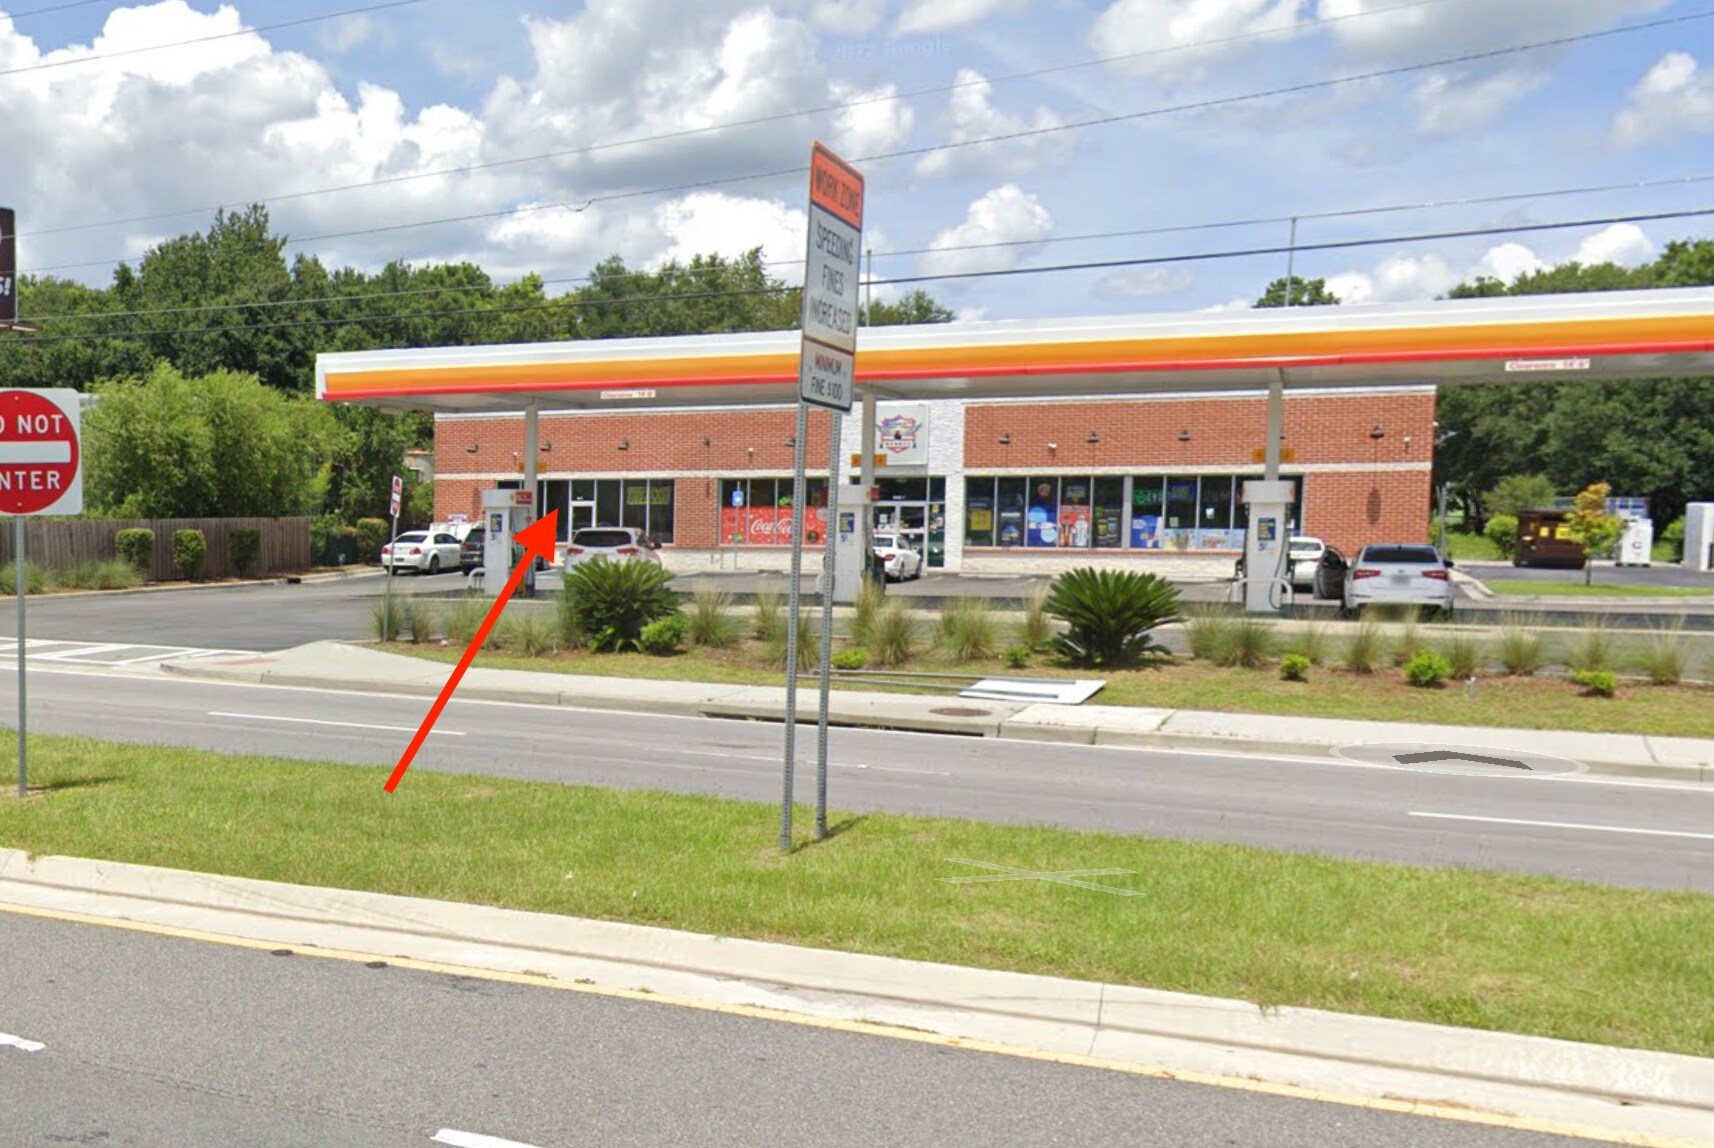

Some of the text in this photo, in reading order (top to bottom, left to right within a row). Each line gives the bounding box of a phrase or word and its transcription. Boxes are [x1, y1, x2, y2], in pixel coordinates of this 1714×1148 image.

[816, 169, 860, 218] WORK ZONE
[816, 219, 854, 266] SPEEDING
[822, 264, 844, 297] FINES
[810, 296, 851, 335] INCREASED
[815, 353, 841, 376] MINIMUM
[811, 375, 843, 401] FINE $100
[17, 414, 63, 434] NOT
[0, 470, 60, 490] NTER
